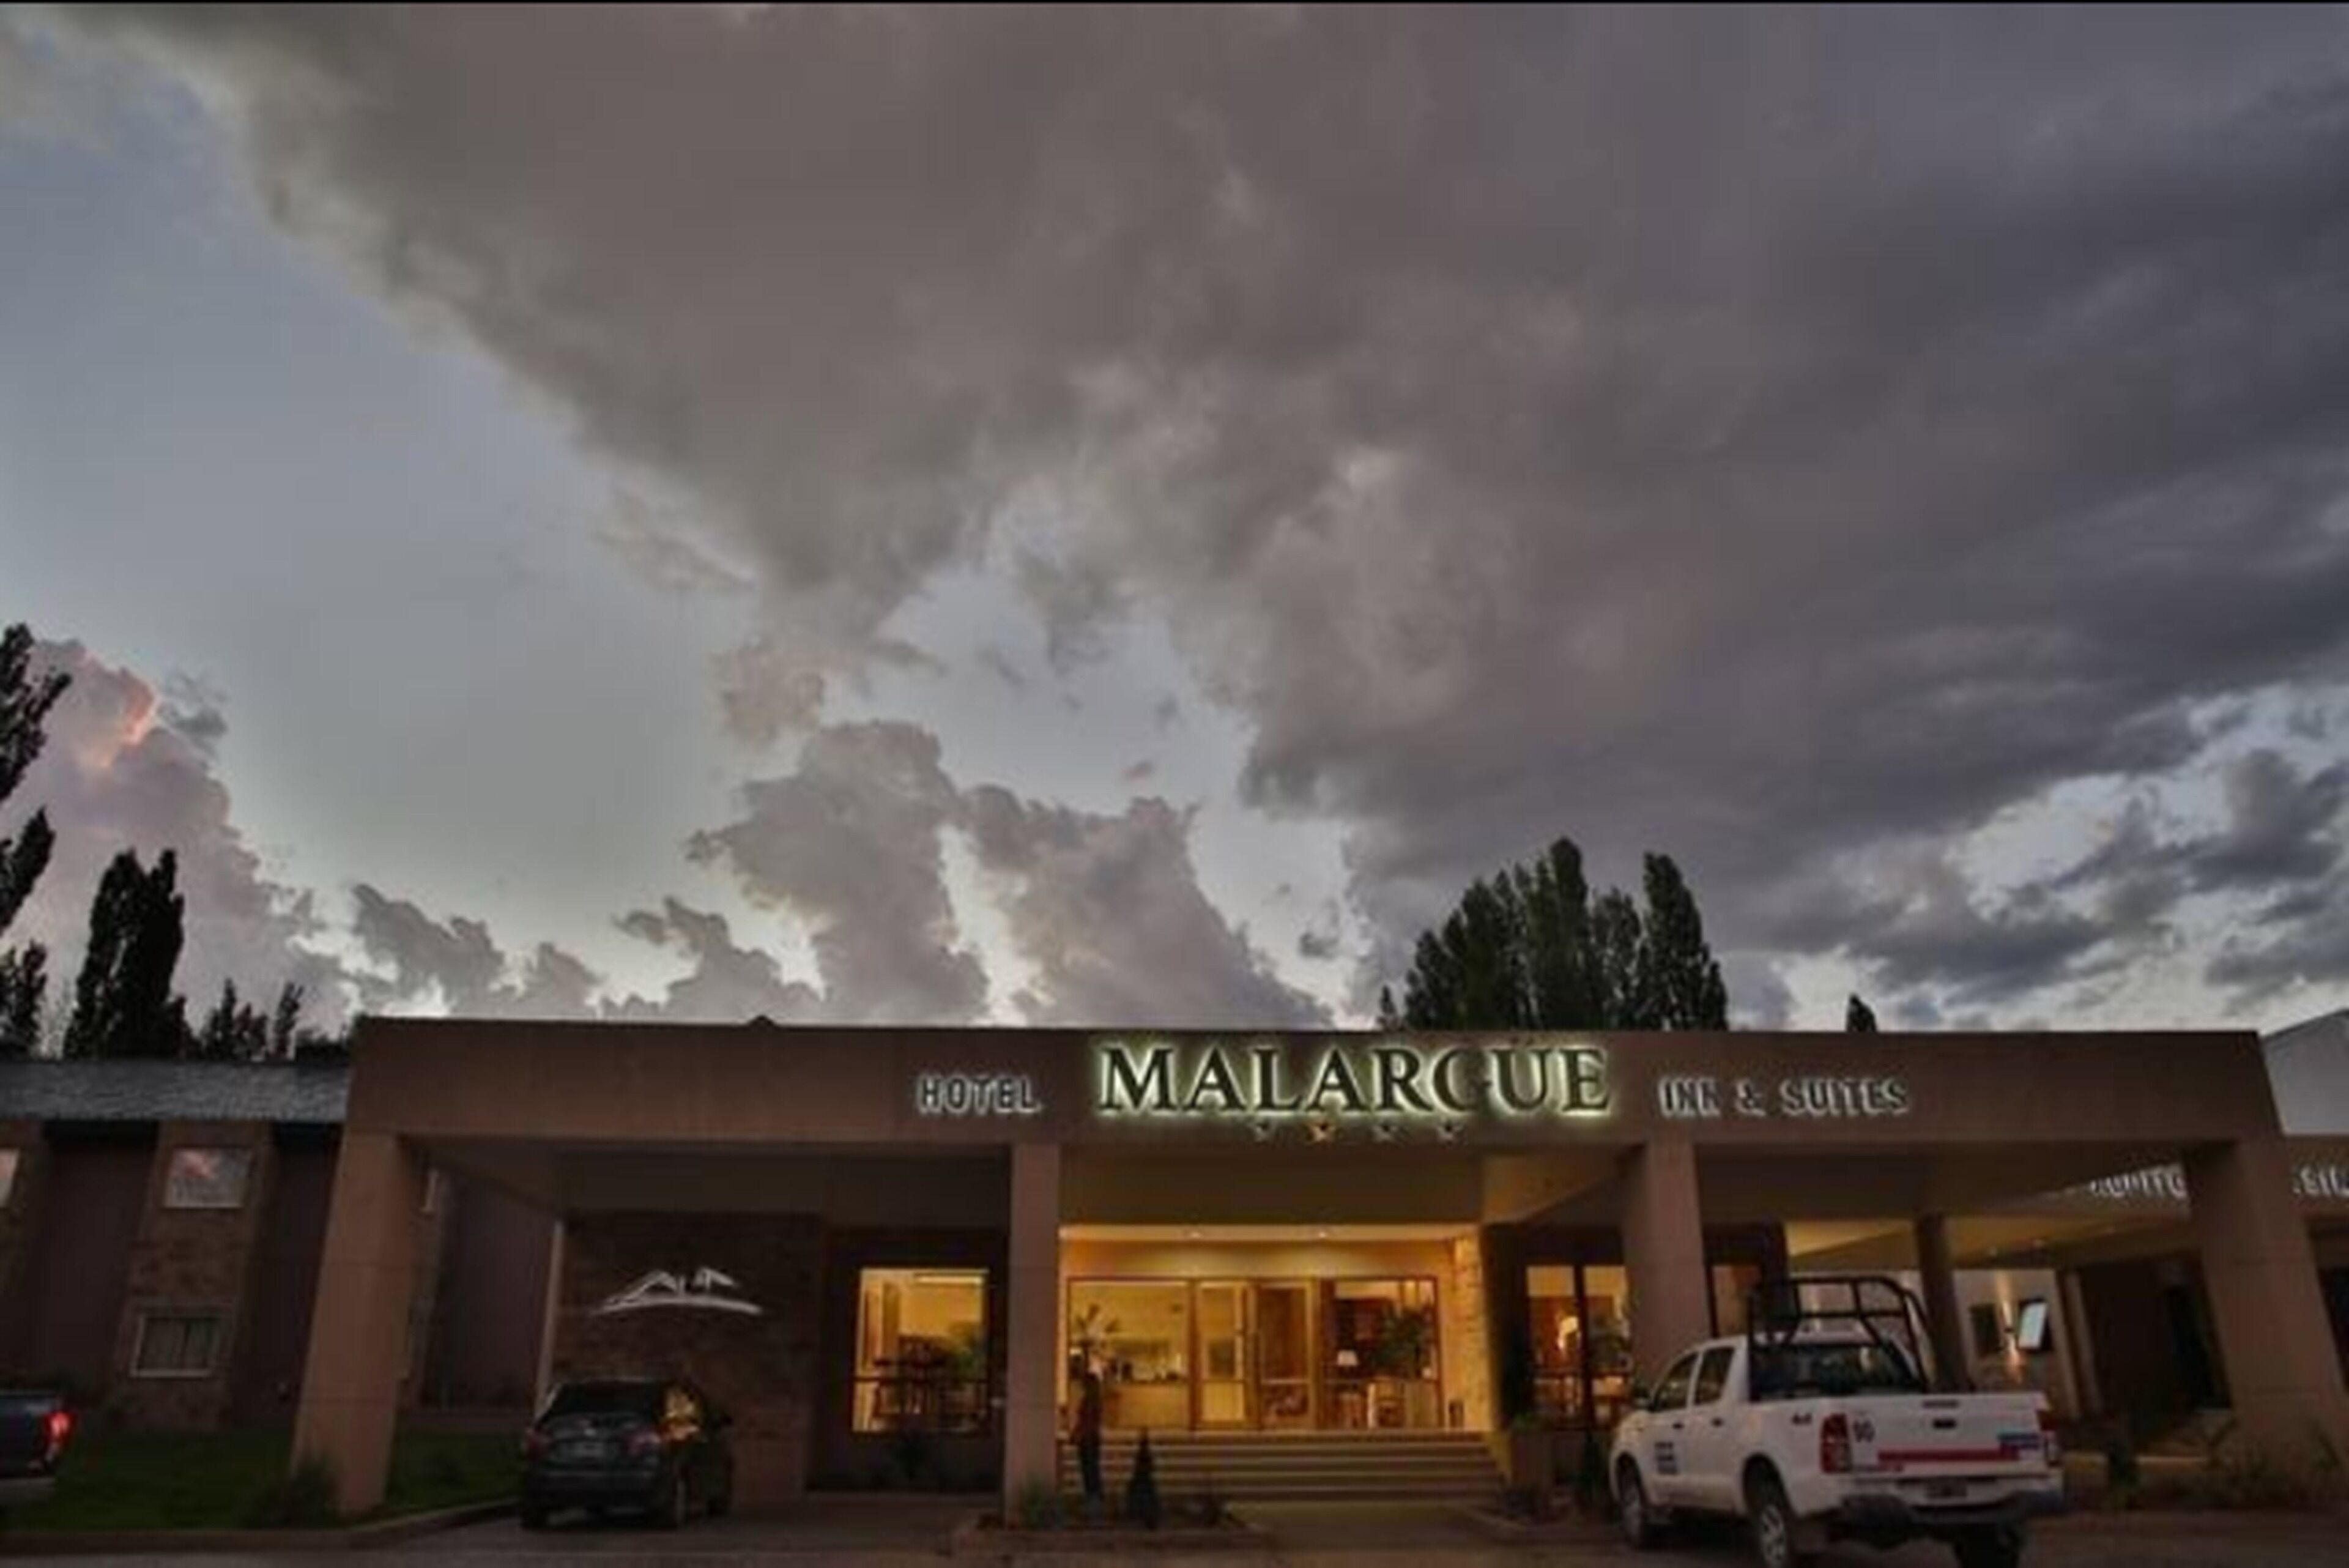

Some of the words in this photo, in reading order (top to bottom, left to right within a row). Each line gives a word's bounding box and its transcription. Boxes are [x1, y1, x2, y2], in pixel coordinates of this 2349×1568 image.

[917, 1075, 1042, 1113] HOTEL
[1657, 1077, 1720, 1118] INN
[1734, 1077, 1766, 1117] &
[1778, 1077, 1909, 1119] SUITES
